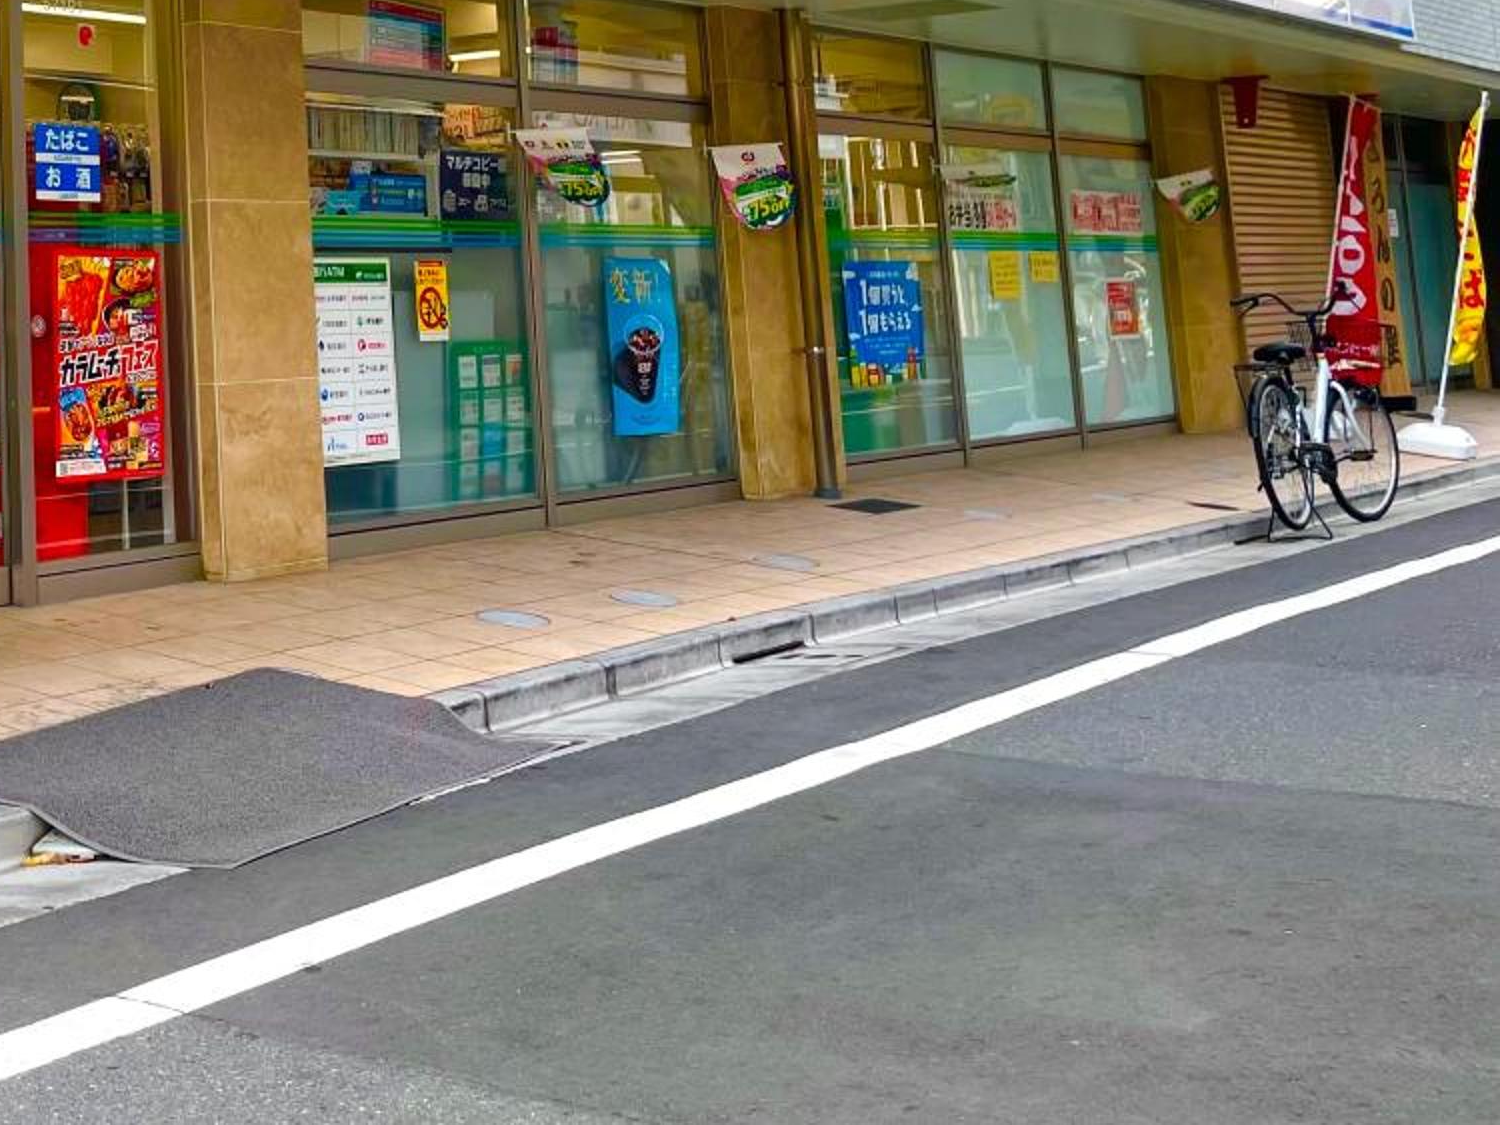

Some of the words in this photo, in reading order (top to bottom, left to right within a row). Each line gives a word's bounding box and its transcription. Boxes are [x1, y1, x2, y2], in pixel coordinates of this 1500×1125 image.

[45, 128, 90, 152] たばこ
[45, 166, 92, 190] お酒
